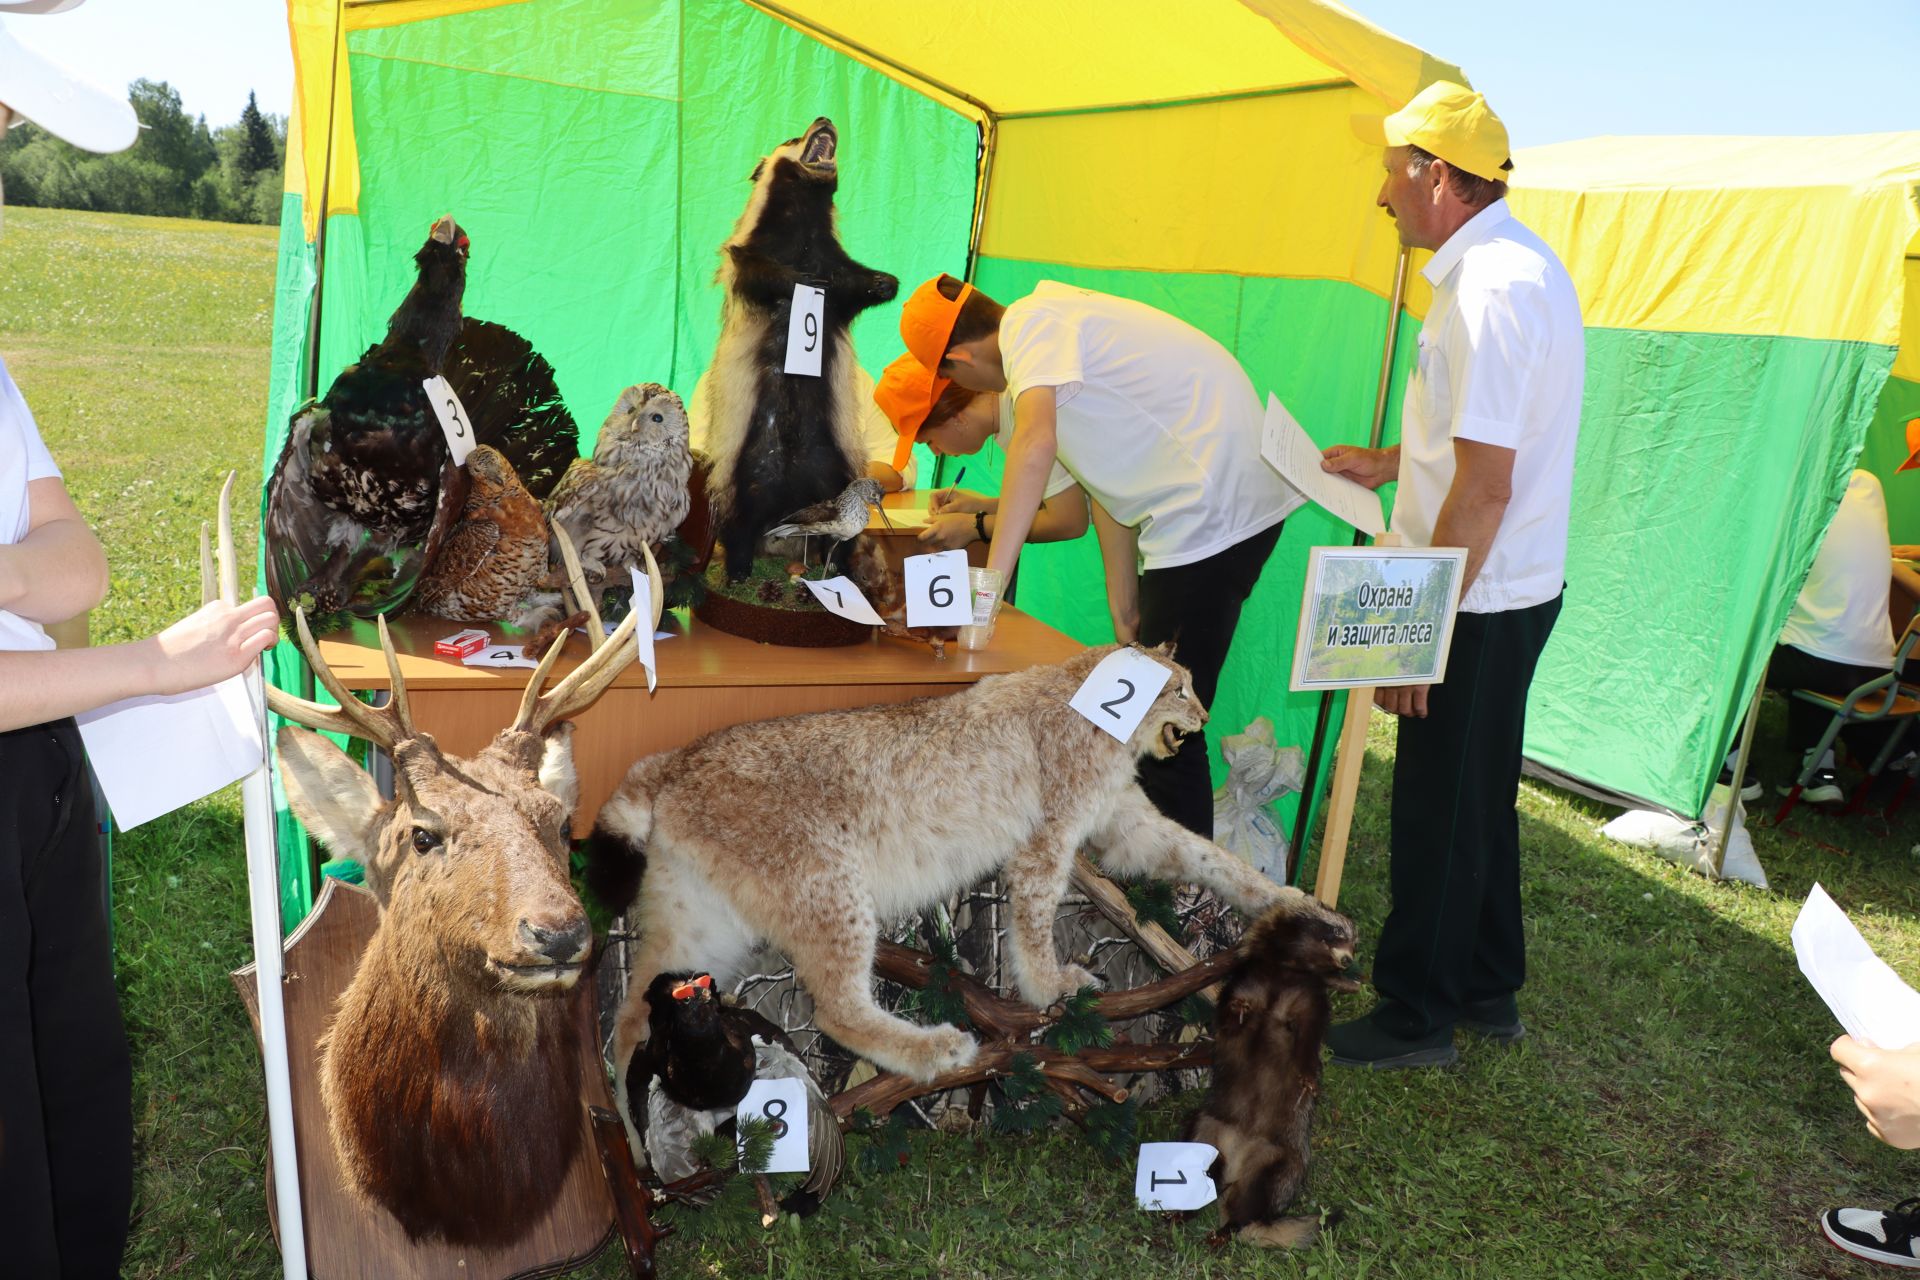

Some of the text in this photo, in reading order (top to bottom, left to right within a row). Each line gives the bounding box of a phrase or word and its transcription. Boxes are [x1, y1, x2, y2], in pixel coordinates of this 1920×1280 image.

[804, 312, 818, 353] 9
[446, 398, 465, 438] 3
[928, 574, 955, 608] 6
[1358, 581, 1414, 614] Охрана
[1327, 622, 1433, 650] и защита леса
[489, 650, 519, 660] 4
[1099, 678, 1136, 720] 2
[762, 1098, 789, 1140] 8
[1150, 1169, 1188, 1193] 1
